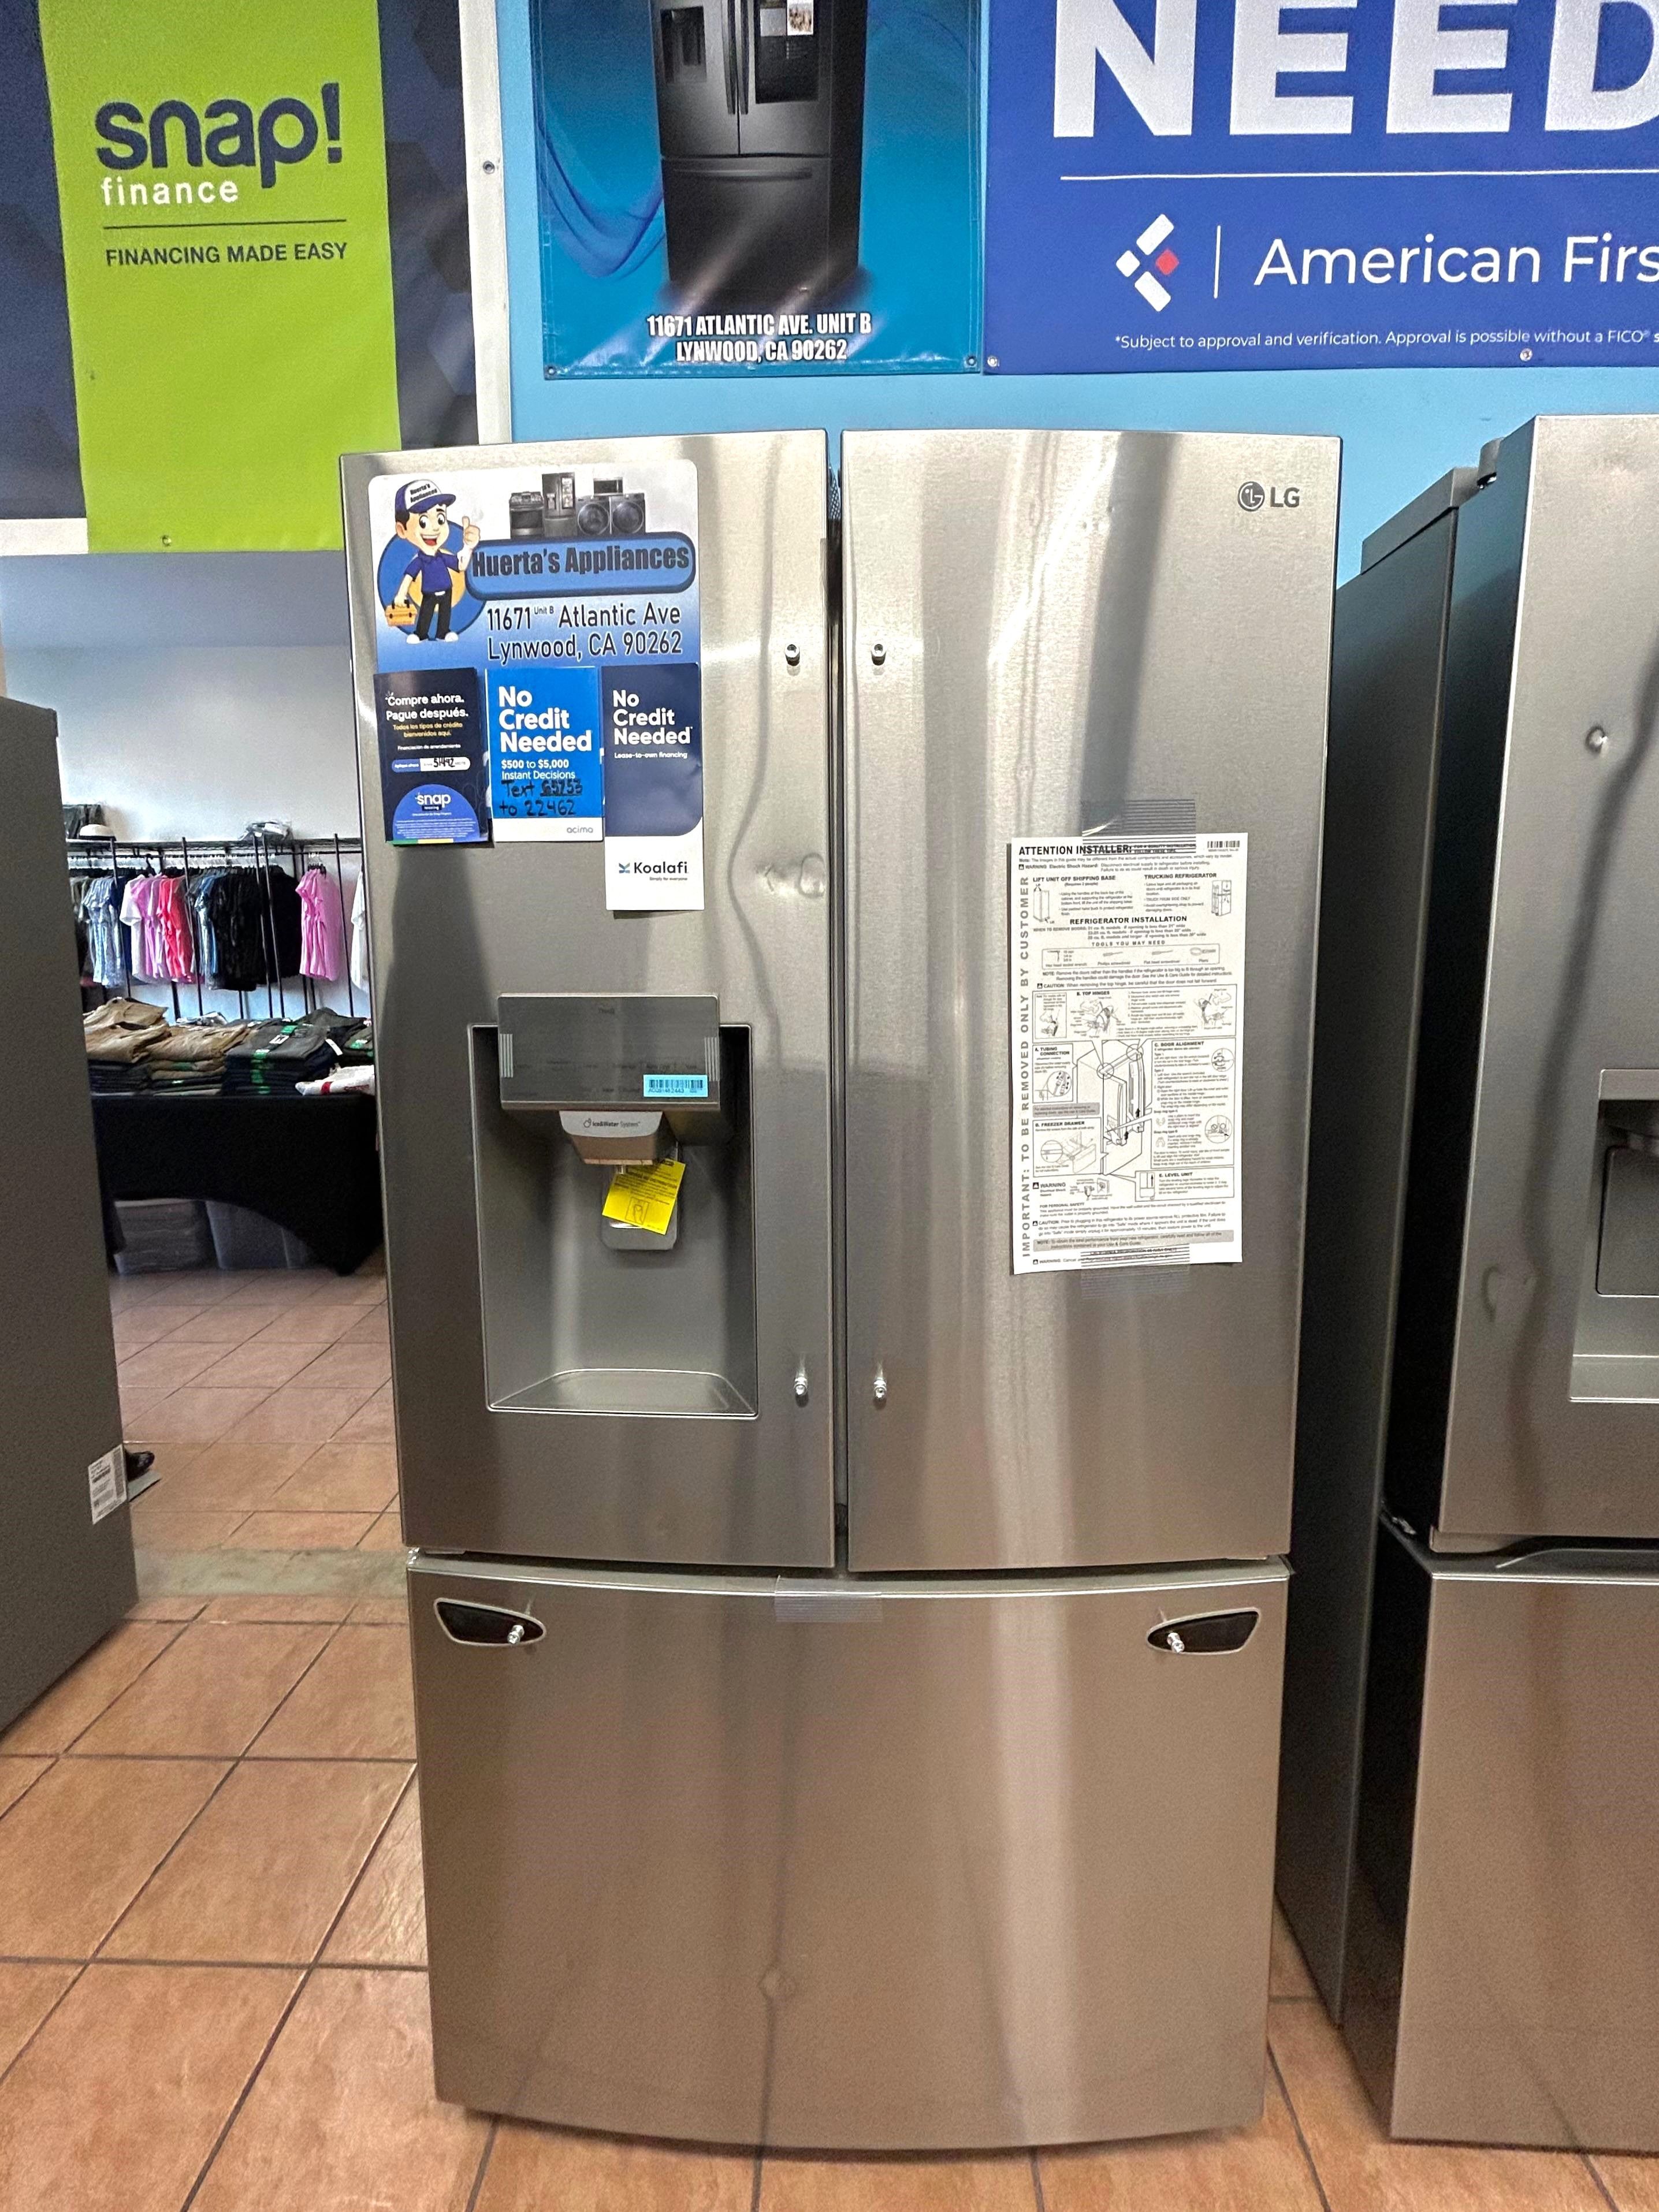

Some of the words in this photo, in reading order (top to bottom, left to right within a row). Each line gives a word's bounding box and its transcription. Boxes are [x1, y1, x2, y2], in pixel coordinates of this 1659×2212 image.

[95, 82, 342, 189] snap!
[101, 177, 238, 206] finance
[106, 245, 220, 266] FINANCING
[227, 244, 287, 263] MADE
[295, 242, 347, 260] EASY
[1253, 233, 1541, 286] American
[1563, 232, 1659, 283] Firs
[647, 315, 693, 337] 11671
[695, 314, 775, 336] ATLANTIC
[779, 314, 813, 335] AVE.
[817, 312, 857, 334] UNIT
[859, 312, 872, 334] B
[676, 341, 762, 363] LYNWOOD,
[764, 341, 789, 361] CA
[791, 339, 847, 360] 90262
[1179, 336, 1194, 348] to
[1198, 333, 1260, 351] approval
[1265, 333, 1293, 346] and
[1296, 331, 1382, 346] verification.
[1385, 330, 1451, 347] Approval
[1455, 330, 1467, 342] is
[1470, 329, 1530, 345] possible
[1534, 329, 1591, 342] without
[1594, 333, 1604, 342] a
[1270, 486, 1300, 508] LG
[472, 549, 560, 577] Huerta's
[565, 546, 690, 575] Appliances
[487, 607, 531, 631] 11671
[534, 606, 548, 615] Unit
[549, 606, 555, 615] B
[559, 603, 635, 628] Atlantic
[643, 602, 680, 625] Ave
[489, 634, 582, 665] Lynwood,
[589, 633, 616, 656] CA
[623, 631, 682, 654] 90262
[388, 696, 429, 707] Compre
[431, 694, 464, 703] ahora.
[499, 686, 533, 707] No
[613, 690, 639, 707] No
[386, 711, 417, 722] Pague
[420, 707, 468, 720] después.
[499, 707, 570, 730] Credit
[613, 707, 675, 726] Credit
[500, 729, 592, 753] Needed
[501, 759, 524, 769] $500
[526, 760, 536, 768] to
[538, 759, 569, 769] $5,000
[502, 771, 531, 780] Instant
[533, 770, 575, 779] Decisions
[501, 780, 535, 798] Text
[417, 794, 451, 808] snap
[499, 800, 517, 816] to
[524, 799, 576, 817] 22462
[1019, 846, 1073, 855] ATTENTION
[634, 861, 687, 874] Koalafi
[1020, 877, 1028, 960] CUSTOMER
[1020, 968, 1028, 987] BY
[1020, 995, 1029, 1033] ONLY
[1021, 1041, 1029, 1111] REMOVED
[1021, 1118, 1029, 1136] BE
[1021, 1144, 1029, 1162] TO
[1022, 1169, 1030, 1258] IMPORTANT:
